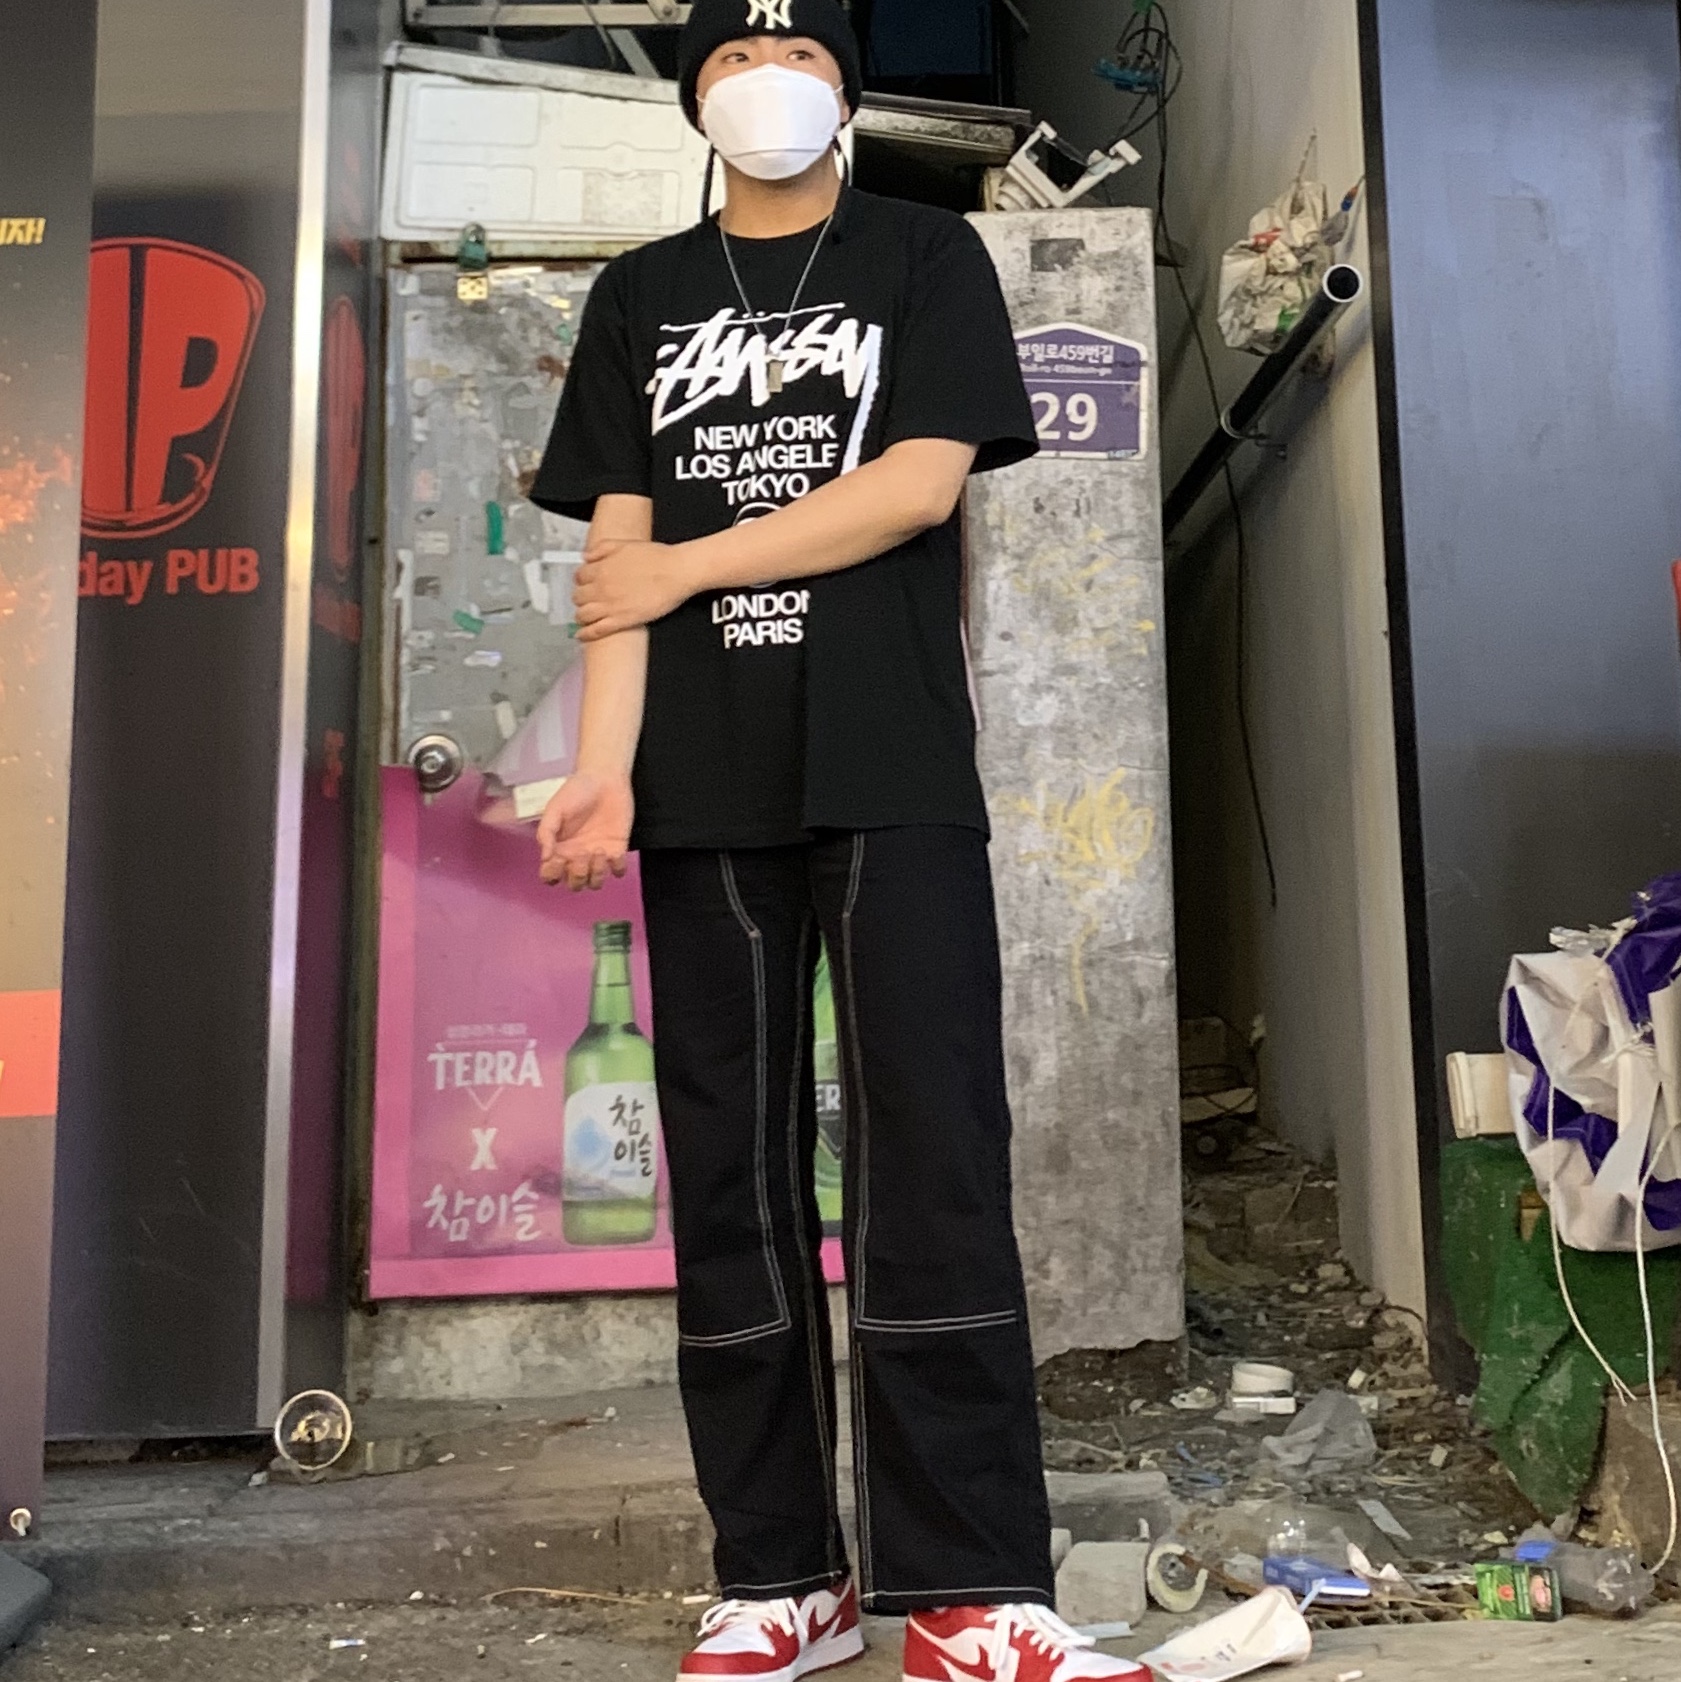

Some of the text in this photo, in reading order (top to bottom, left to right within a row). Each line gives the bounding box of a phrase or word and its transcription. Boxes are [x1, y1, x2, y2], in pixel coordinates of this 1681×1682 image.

[746, 0, 793, 29] NY
[1016, 343, 1115, 364] 부일로459번길
[695, 414, 837, 450] NEW YORK
[1031, 392, 1098, 441] 29
[675, 455, 731, 480] LOS
[722, 473, 809, 505] TOKYO
[166, 547, 260, 594] PUB
[724, 619, 804, 649] PARIS
[609, 1094, 645, 1136] 참
[422, 1178, 540, 1242] 참이슬
